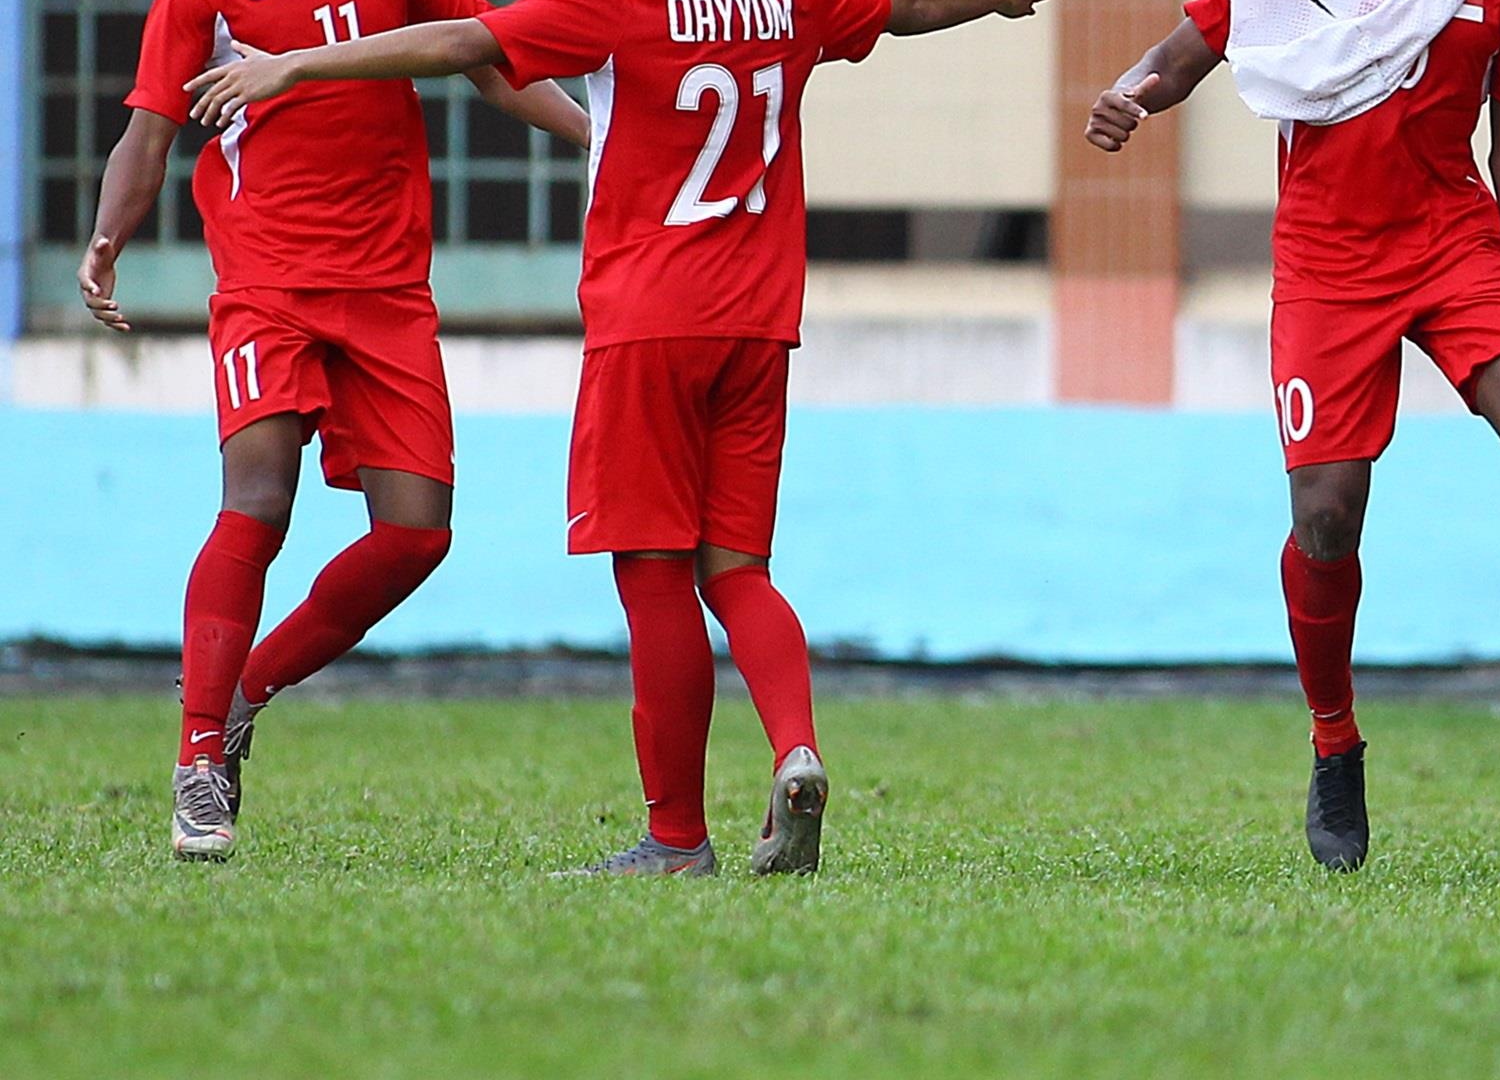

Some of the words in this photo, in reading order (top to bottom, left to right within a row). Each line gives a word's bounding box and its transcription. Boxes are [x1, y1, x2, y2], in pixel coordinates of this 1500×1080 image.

[313, 0, 361, 45] 11
[663, 60, 784, 226] 21
[223, 340, 261, 410] 11
[1276, 377, 1314, 447] 10
